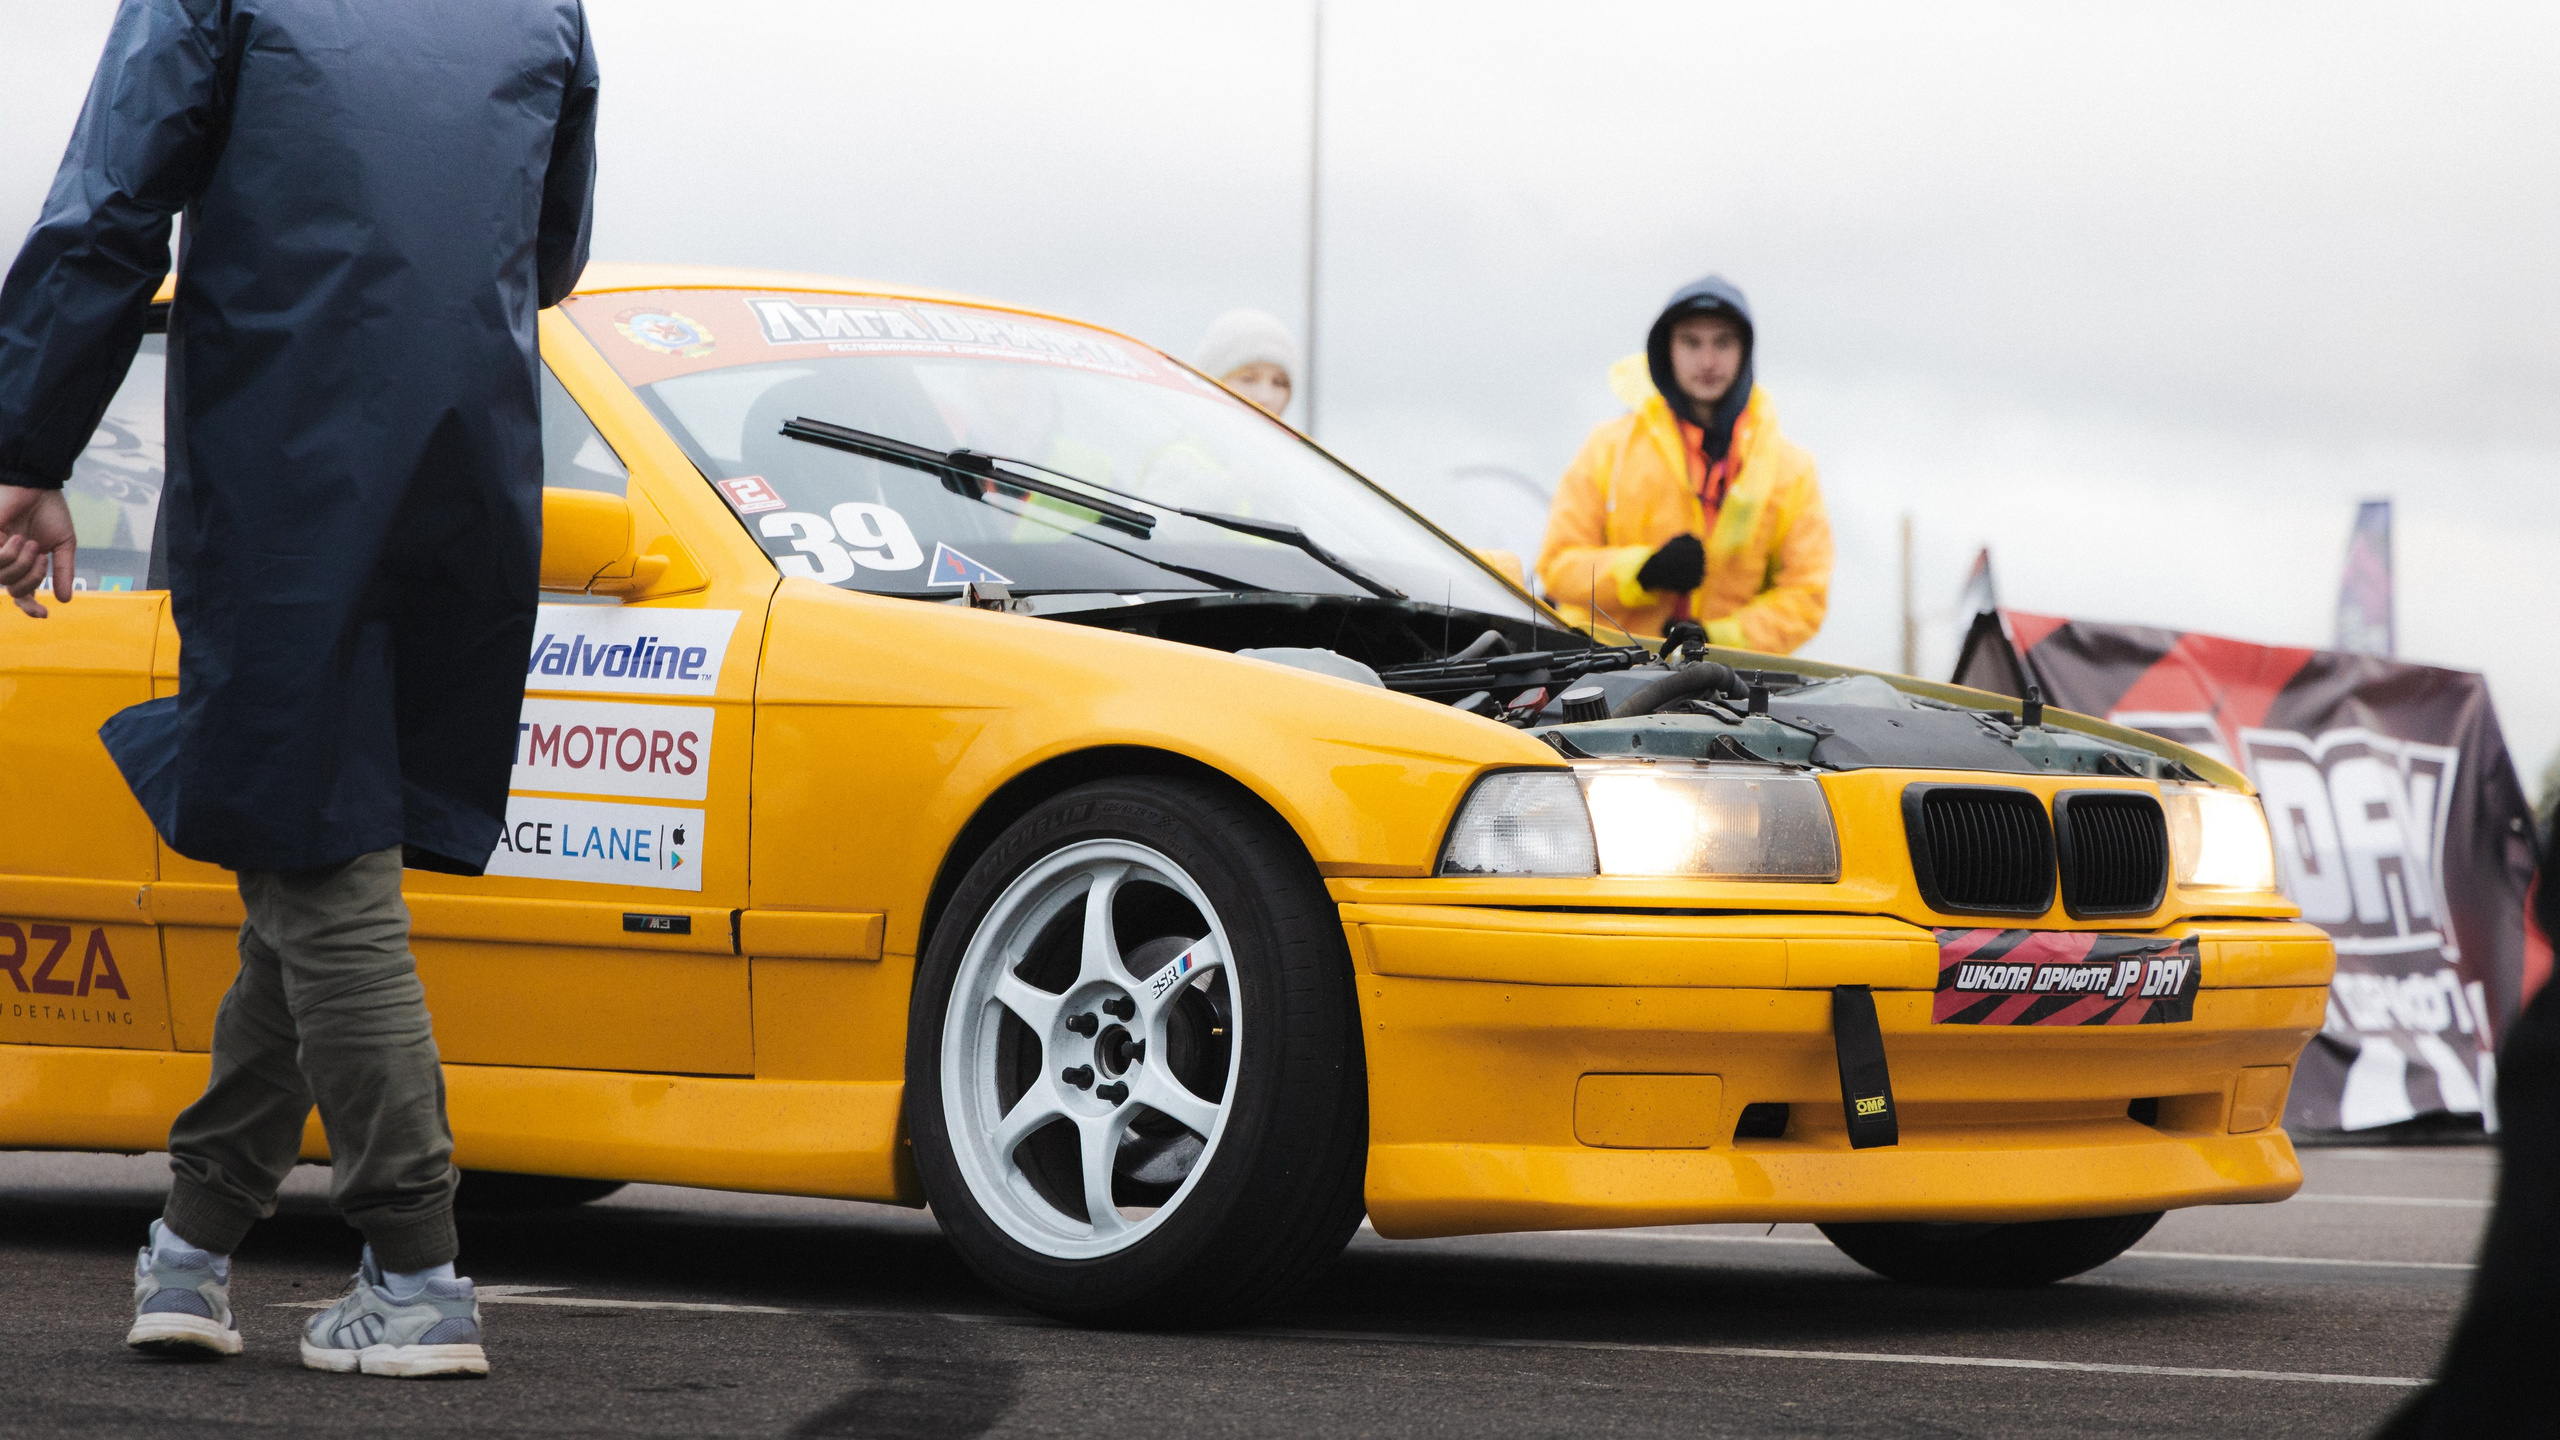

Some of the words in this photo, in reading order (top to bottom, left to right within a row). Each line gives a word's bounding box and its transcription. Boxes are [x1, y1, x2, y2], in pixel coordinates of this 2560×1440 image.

[728, 479, 771, 504] 2
[758, 501, 925, 585] 39
[562, 823, 652, 863] LANE
[982, 803, 1089, 881] MICHELIN
[649, 917, 671, 930] M3
[0, 921, 131, 1000] RZA
[1955, 964, 2034, 991] ШКОЛА
[2032, 966, 2113, 992] ДРИФТА
[2107, 960, 2142, 998] JP
[2139, 958, 2191, 997] DAY
[1150, 965, 1180, 1001] SSR
[13, 1003, 134, 1026] DETAILING
[1855, 1097, 1886, 1114] OMP
